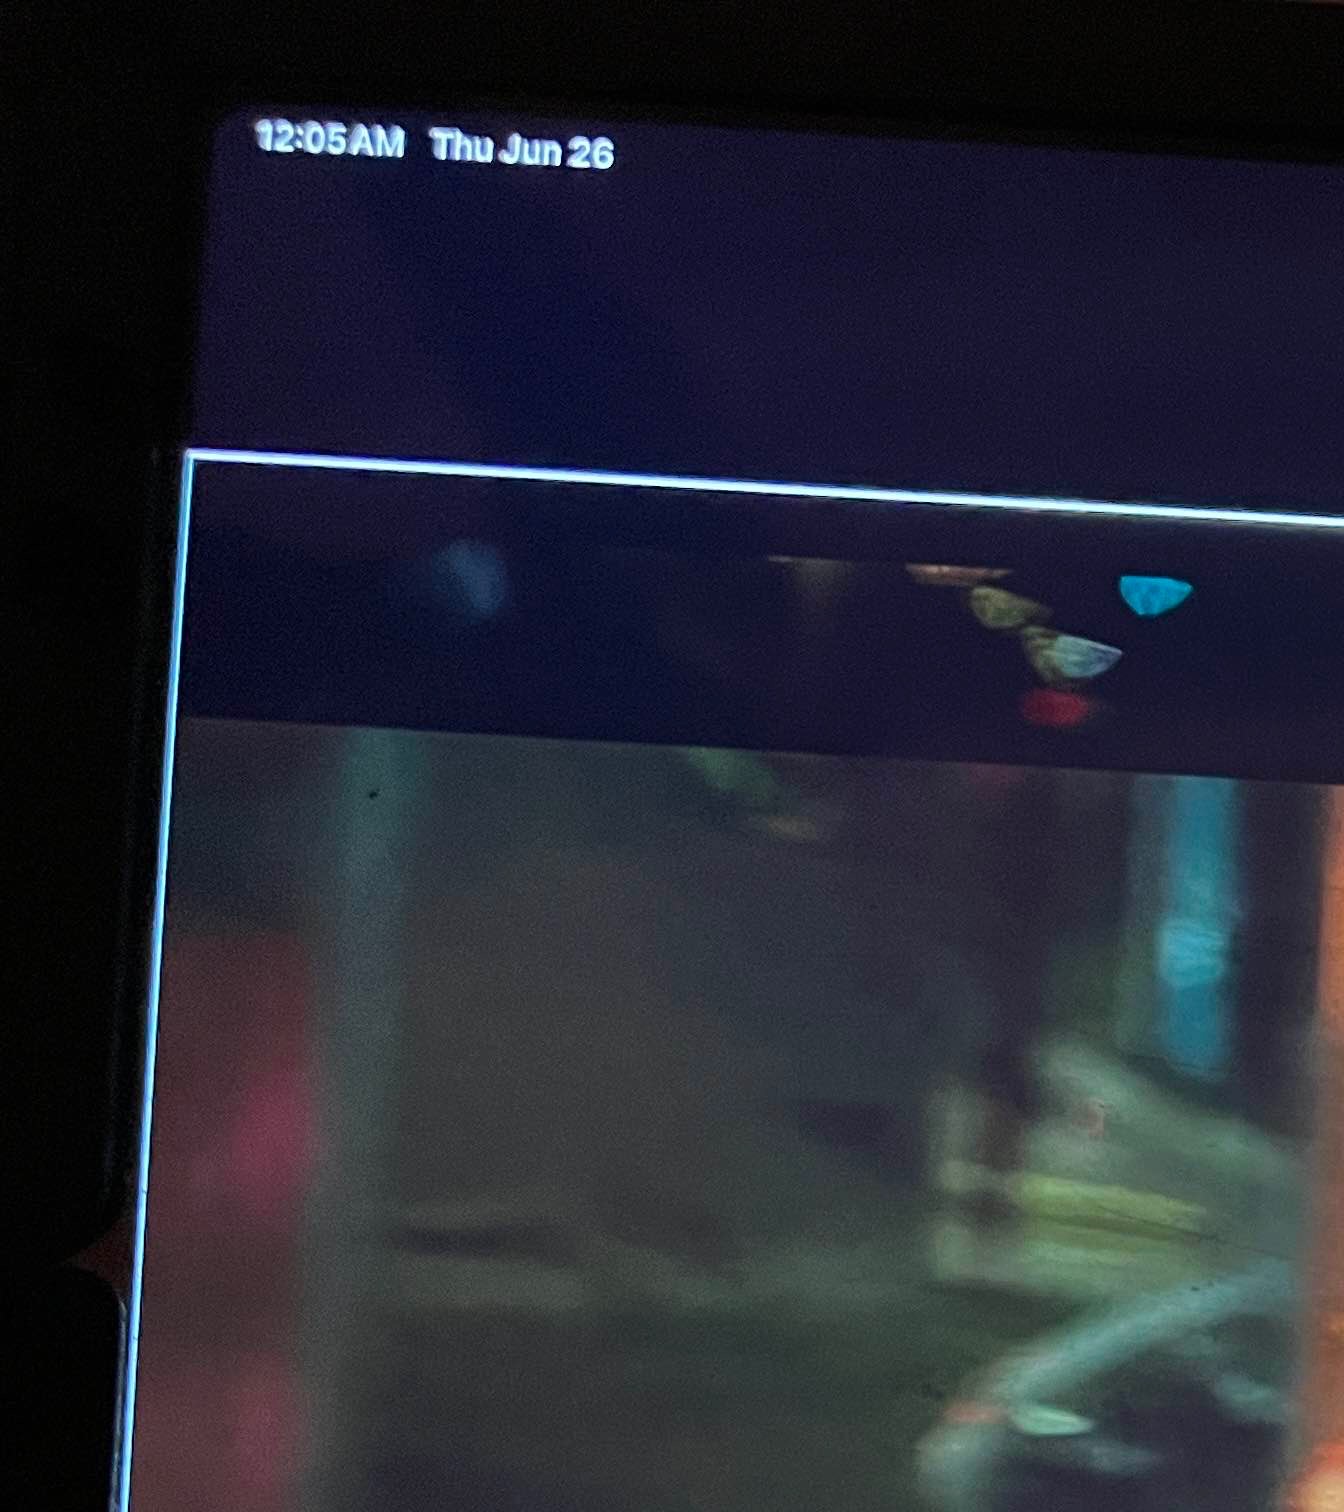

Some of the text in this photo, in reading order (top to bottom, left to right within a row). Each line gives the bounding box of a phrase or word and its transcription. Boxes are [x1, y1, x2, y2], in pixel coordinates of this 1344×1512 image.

[428, 127, 494, 163] Thu
[499, 133, 562, 166] Jun
[566, 136, 615, 169] 26
